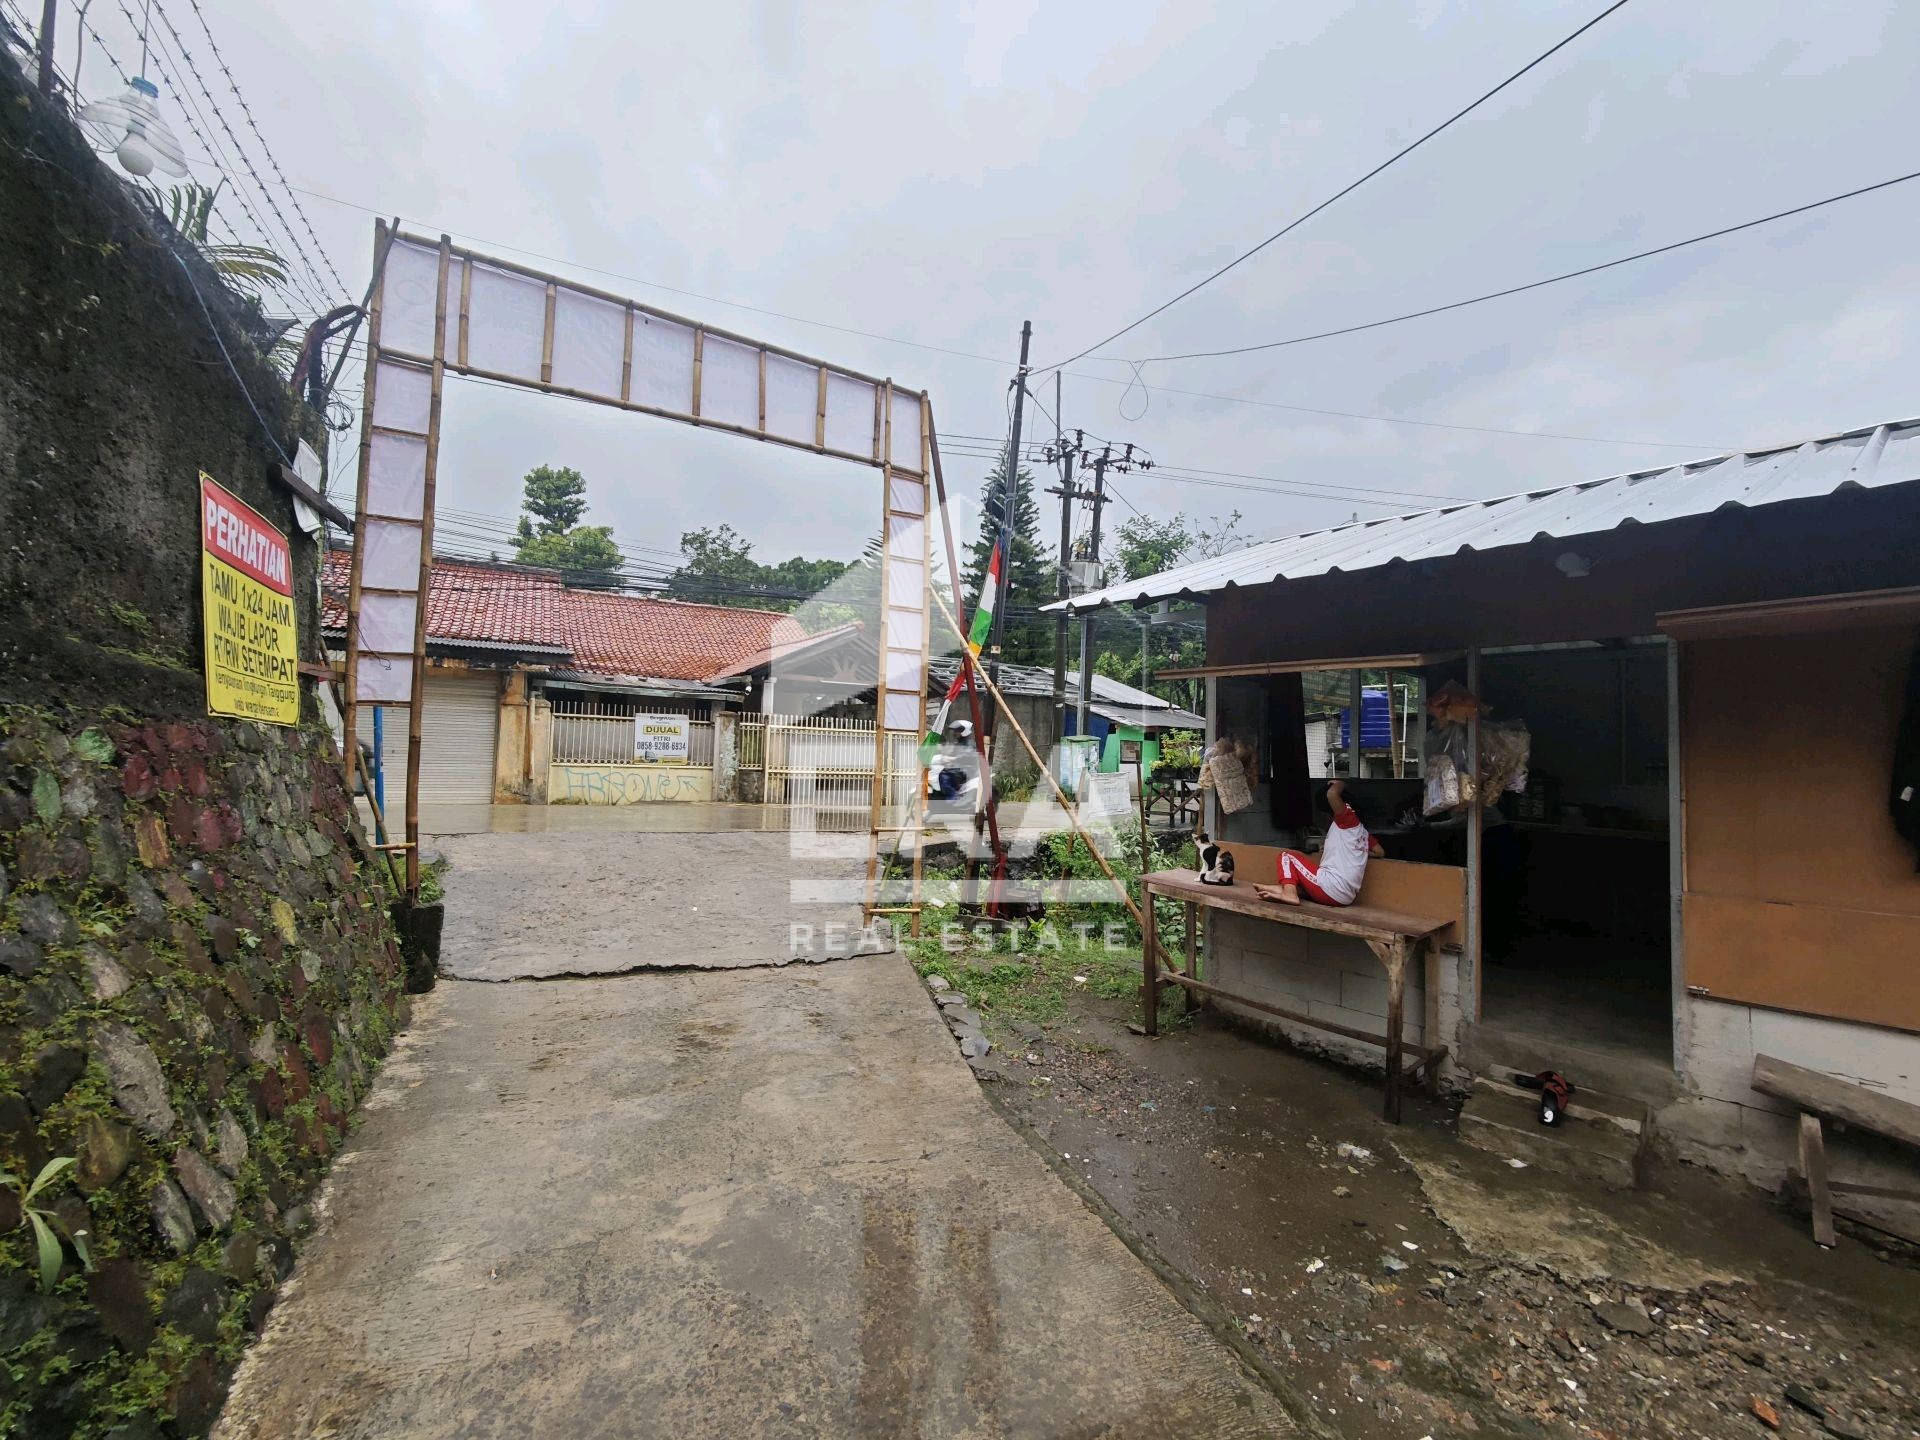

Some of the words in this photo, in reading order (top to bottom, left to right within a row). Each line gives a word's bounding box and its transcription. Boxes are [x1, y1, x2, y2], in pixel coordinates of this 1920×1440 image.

[206, 497, 286, 586] PERHATIAN
[210, 563, 238, 604] TAMU
[242, 583, 263, 617] 1x24
[266, 596, 291, 627] JAM
[218, 601, 246, 641] WAJIB
[248, 617, 280, 653] LAPOR
[214, 632, 240, 669] RT/RW
[242, 645, 295, 682] SETEMPAT
[646, 726, 679, 734] DIJUAL
